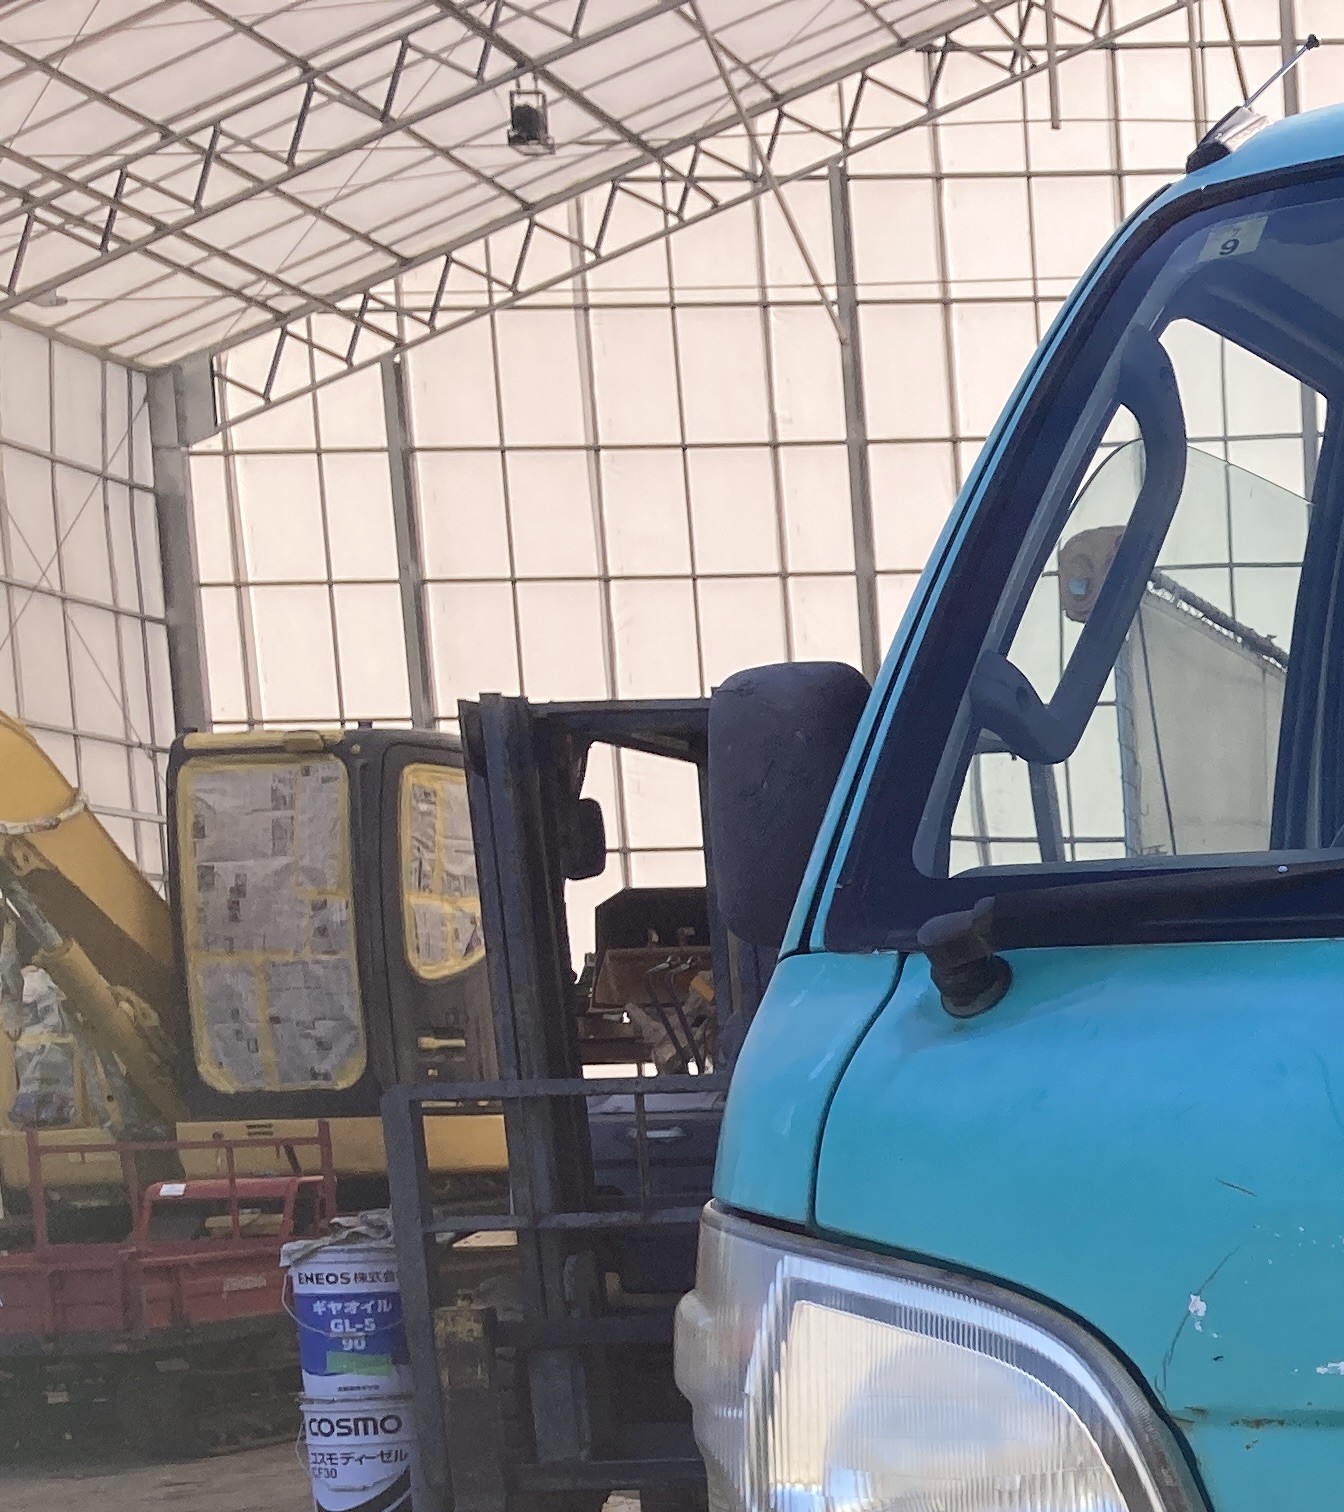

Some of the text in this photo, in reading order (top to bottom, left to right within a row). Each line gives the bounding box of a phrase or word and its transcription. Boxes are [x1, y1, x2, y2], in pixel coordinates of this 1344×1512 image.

[1219, 239, 1240, 256] 9
[313, 1300, 393, 1315] ギヤオイル
[330, 1318, 376, 1332] GL-5
[309, 1415, 402, 1437] COSMO
[311, 1450, 408, 1465] コスモディーゼル
